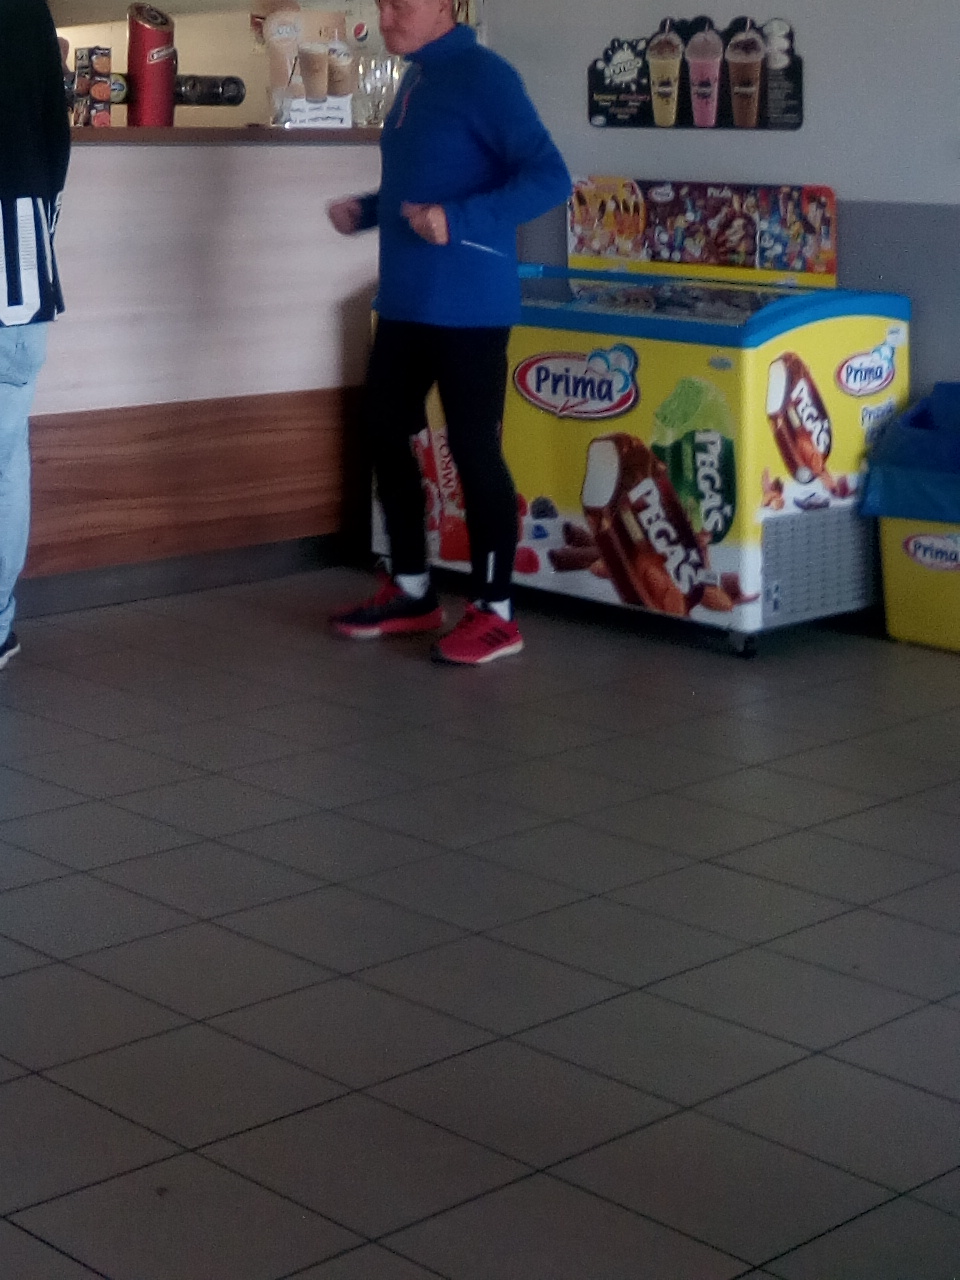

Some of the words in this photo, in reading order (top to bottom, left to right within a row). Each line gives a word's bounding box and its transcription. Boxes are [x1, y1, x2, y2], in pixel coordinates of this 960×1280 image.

[535, 365, 614, 403] Prima
[845, 363, 884, 384] Prima
[913, 540, 958, 563] Prima
